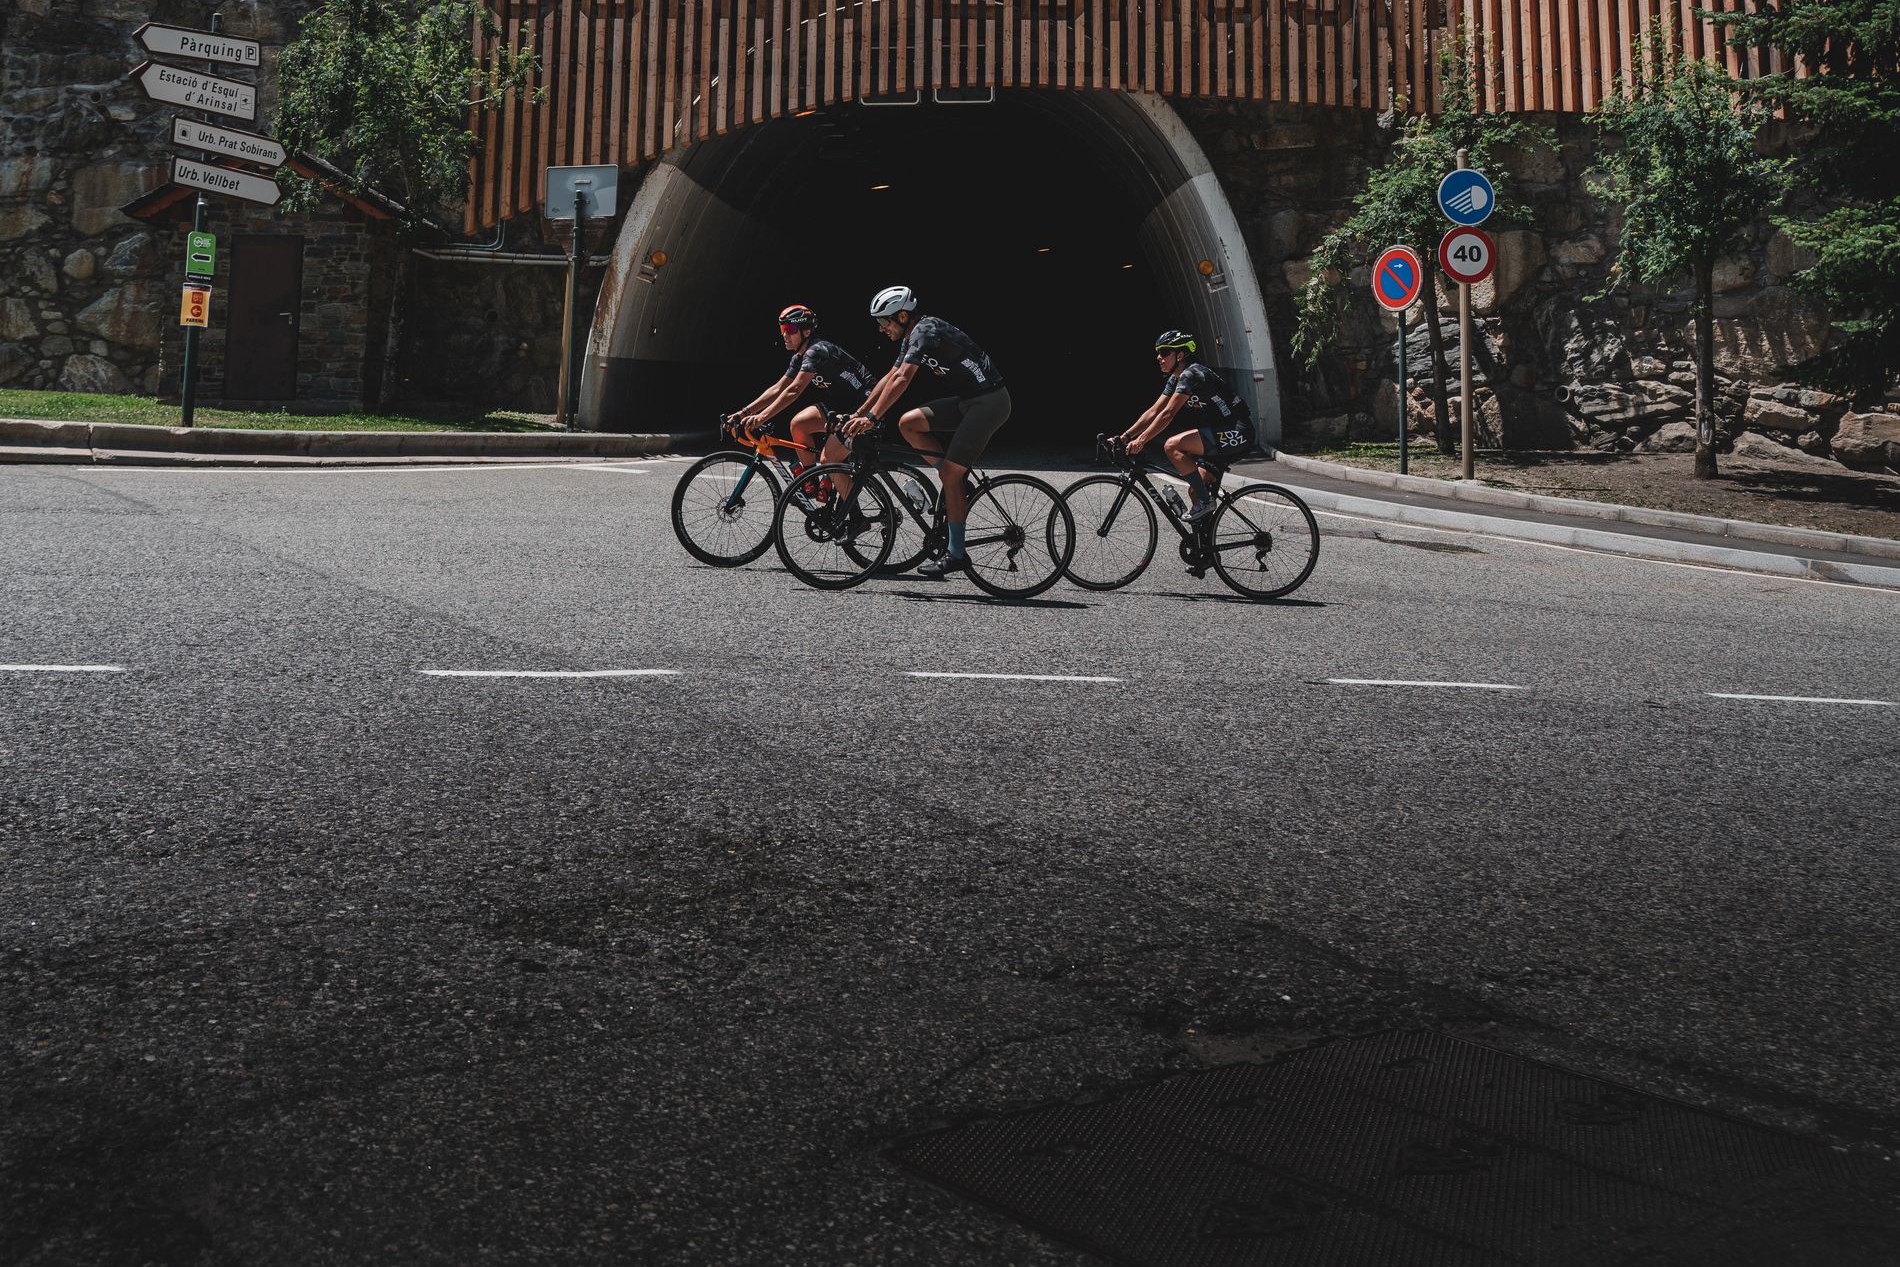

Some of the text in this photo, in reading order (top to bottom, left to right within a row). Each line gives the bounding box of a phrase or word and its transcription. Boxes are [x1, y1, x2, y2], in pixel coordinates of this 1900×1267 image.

[180, 36, 256, 62] Pàrquing P
[159, 69, 198, 88] Estació
[198, 130, 278, 160] Urb. Prat Sobirans
[178, 165, 240, 191] Urb. Vellbet
[1453, 245, 1482, 263] 40
